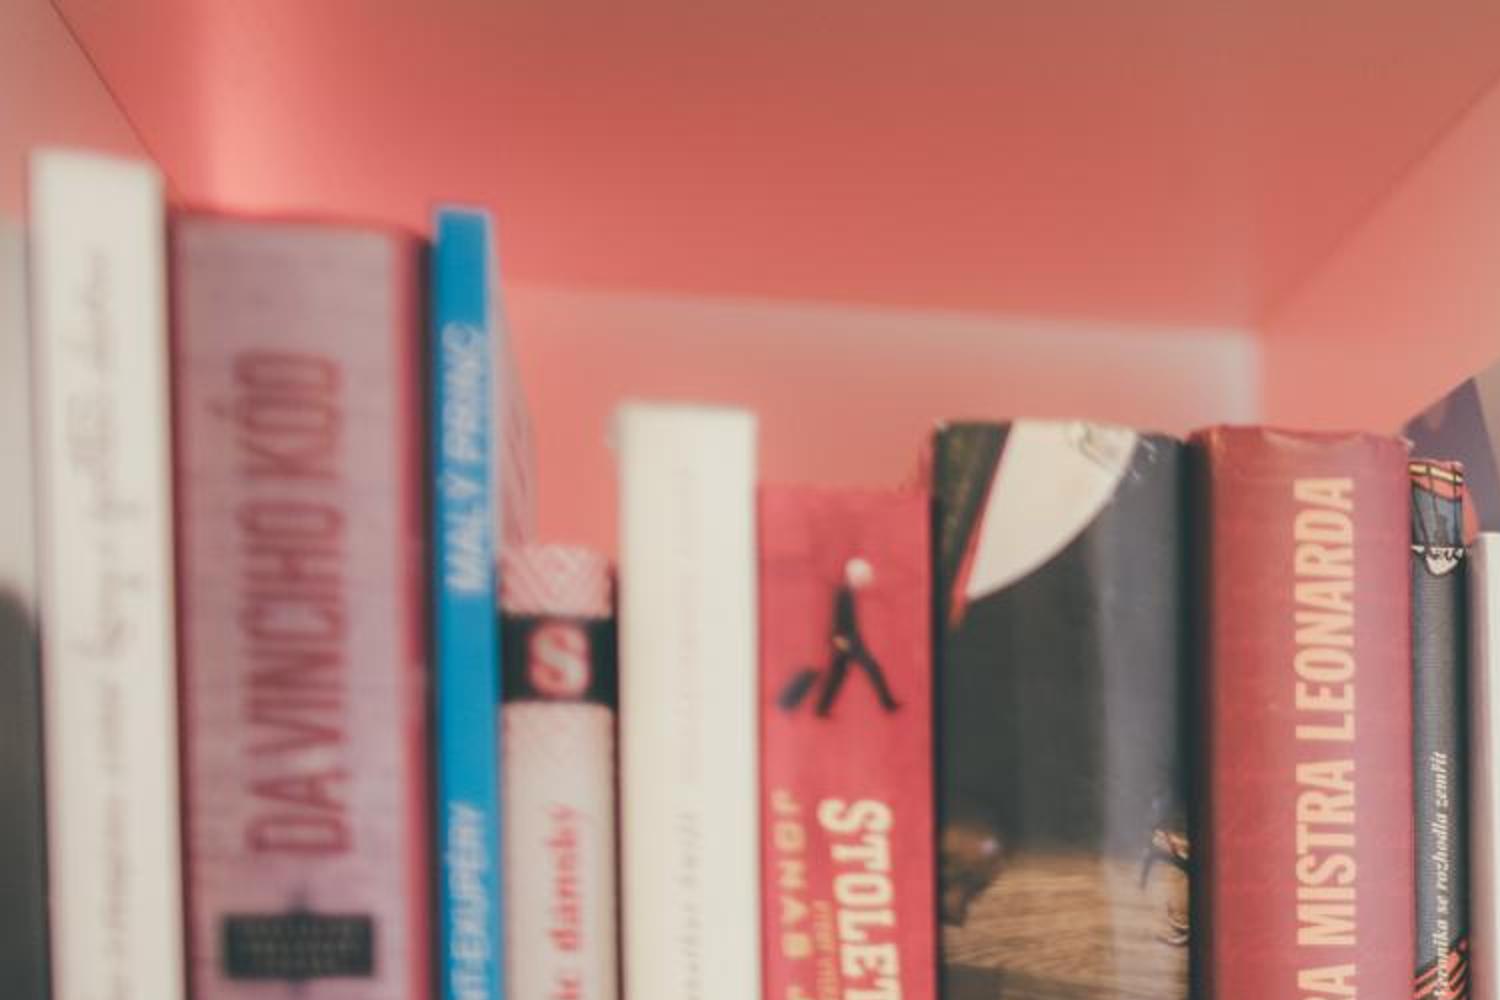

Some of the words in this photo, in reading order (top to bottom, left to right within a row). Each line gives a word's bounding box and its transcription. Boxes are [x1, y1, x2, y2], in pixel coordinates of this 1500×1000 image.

[206, 349, 344, 481] KÓD
[441, 320, 486, 462] PRINC
[235, 498, 348, 759] VINCIHO
[1293, 476, 1356, 742] LEONARDA
[243, 770, 354, 855] DA
[1428, 749, 1450, 807] zemřít
[769, 789, 811, 959] JONAS
[1296, 758, 1357, 946] MISTRA
[1430, 812, 1450, 890] rozhodla
[1436, 893, 1450, 914] se
[1431, 918, 1450, 999] Veronika
